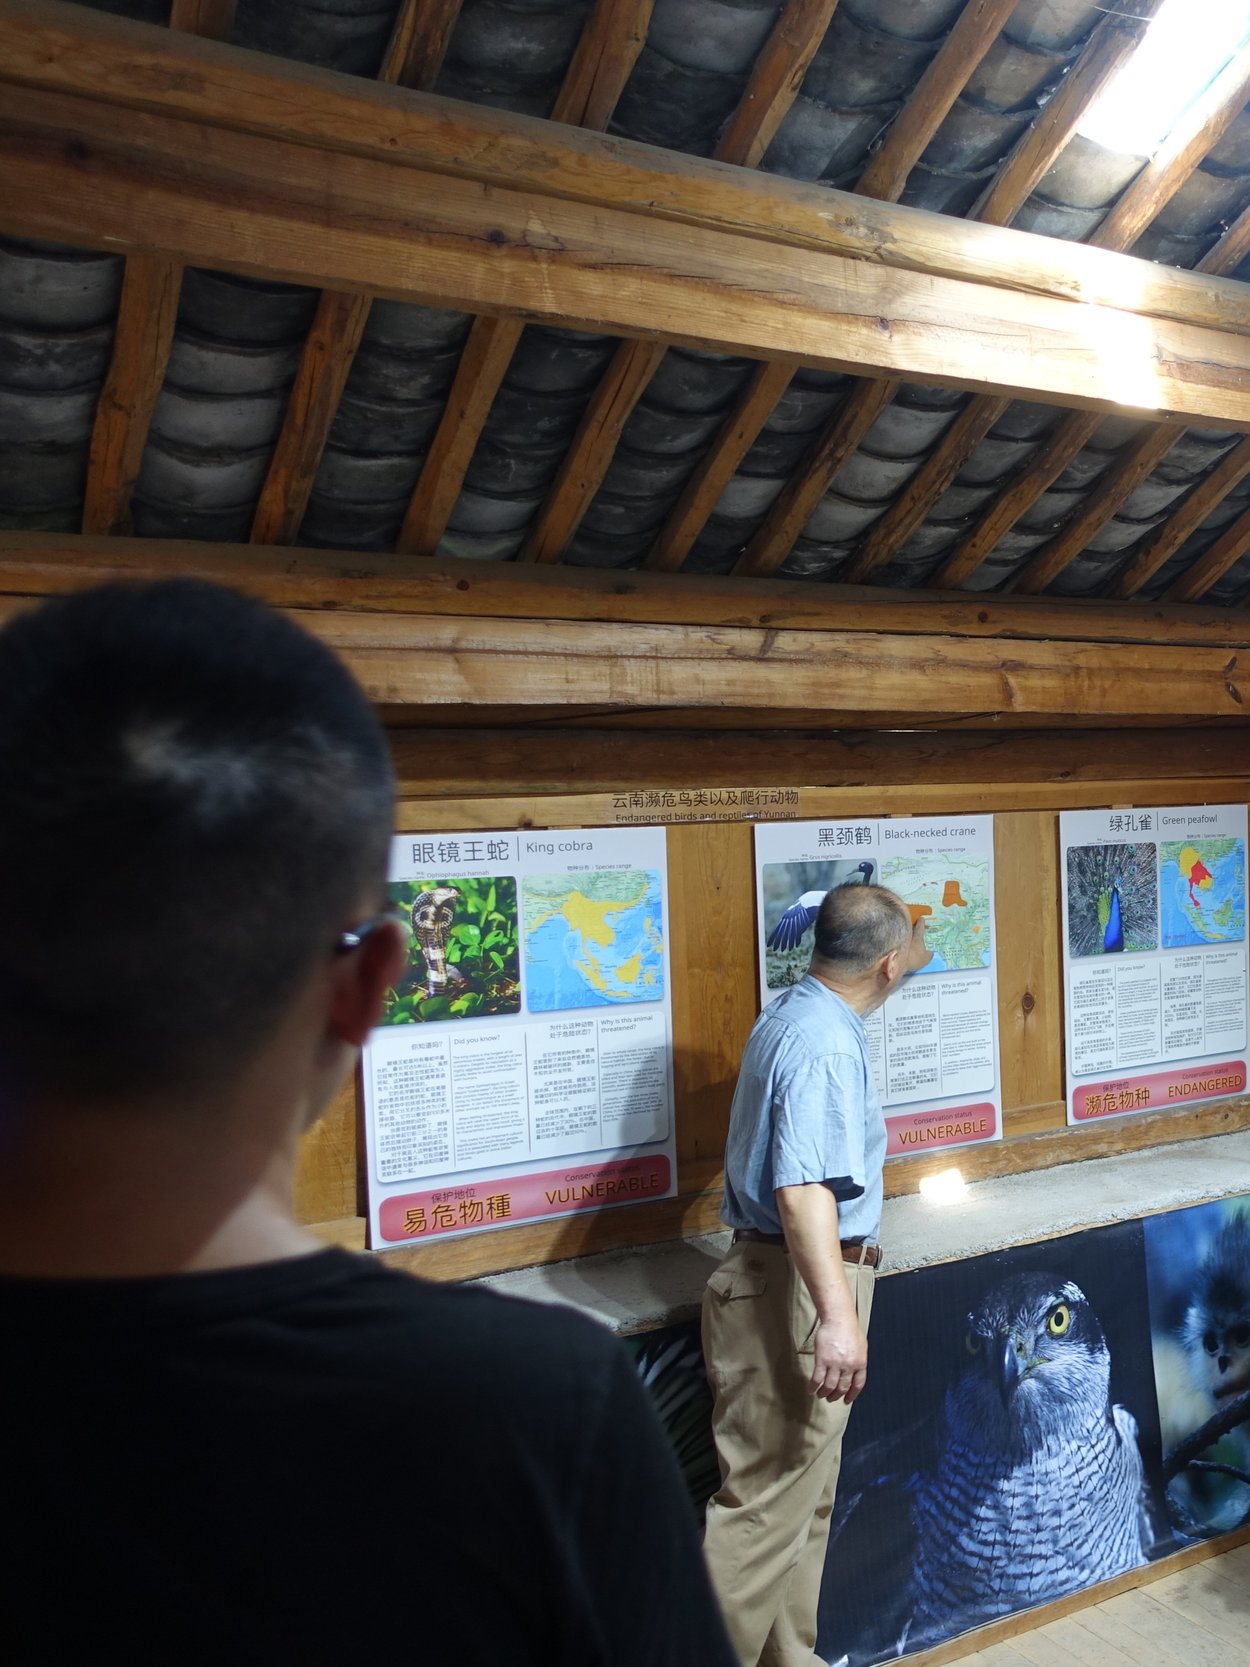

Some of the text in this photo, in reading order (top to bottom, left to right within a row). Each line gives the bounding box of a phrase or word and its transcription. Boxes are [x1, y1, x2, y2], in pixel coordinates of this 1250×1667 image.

[612, 790, 799, 808] 云南濒危鸟类以及爬行动物
[615, 812, 672, 822] Endangered
[674, 811, 697, 820] birds
[700, 811, 716, 820] and
[764, 810, 796, 819] Yunnan
[1109, 814, 1152, 832] 绿孔雀
[1162, 814, 1218, 826] Green peafowl
[818, 826, 872, 847] 黑颈鹤
[884, 826, 976, 839] Black-necked crane
[412, 839, 509, 864] 眼镜王蛇
[526, 840, 593, 854] King cobra
[601, 1024, 636, 1033] threatened?
[480, 1034, 500, 1042] know?
[1183, 1071, 1213, 1079] Conservation
[1168, 1075, 1242, 1098] ENDANGERED
[1085, 1087, 1150, 1115] 濒危物种
[913, 1111, 973, 1125] Conservation status
[899, 1119, 987, 1145] VULNERABLE
[565, 1168, 616, 1182] Conservation
[432, 1188, 476, 1204] 保护地位
[545, 1173, 659, 1205] VULNERABLE
[403, 1193, 512, 1234] 易危物種
